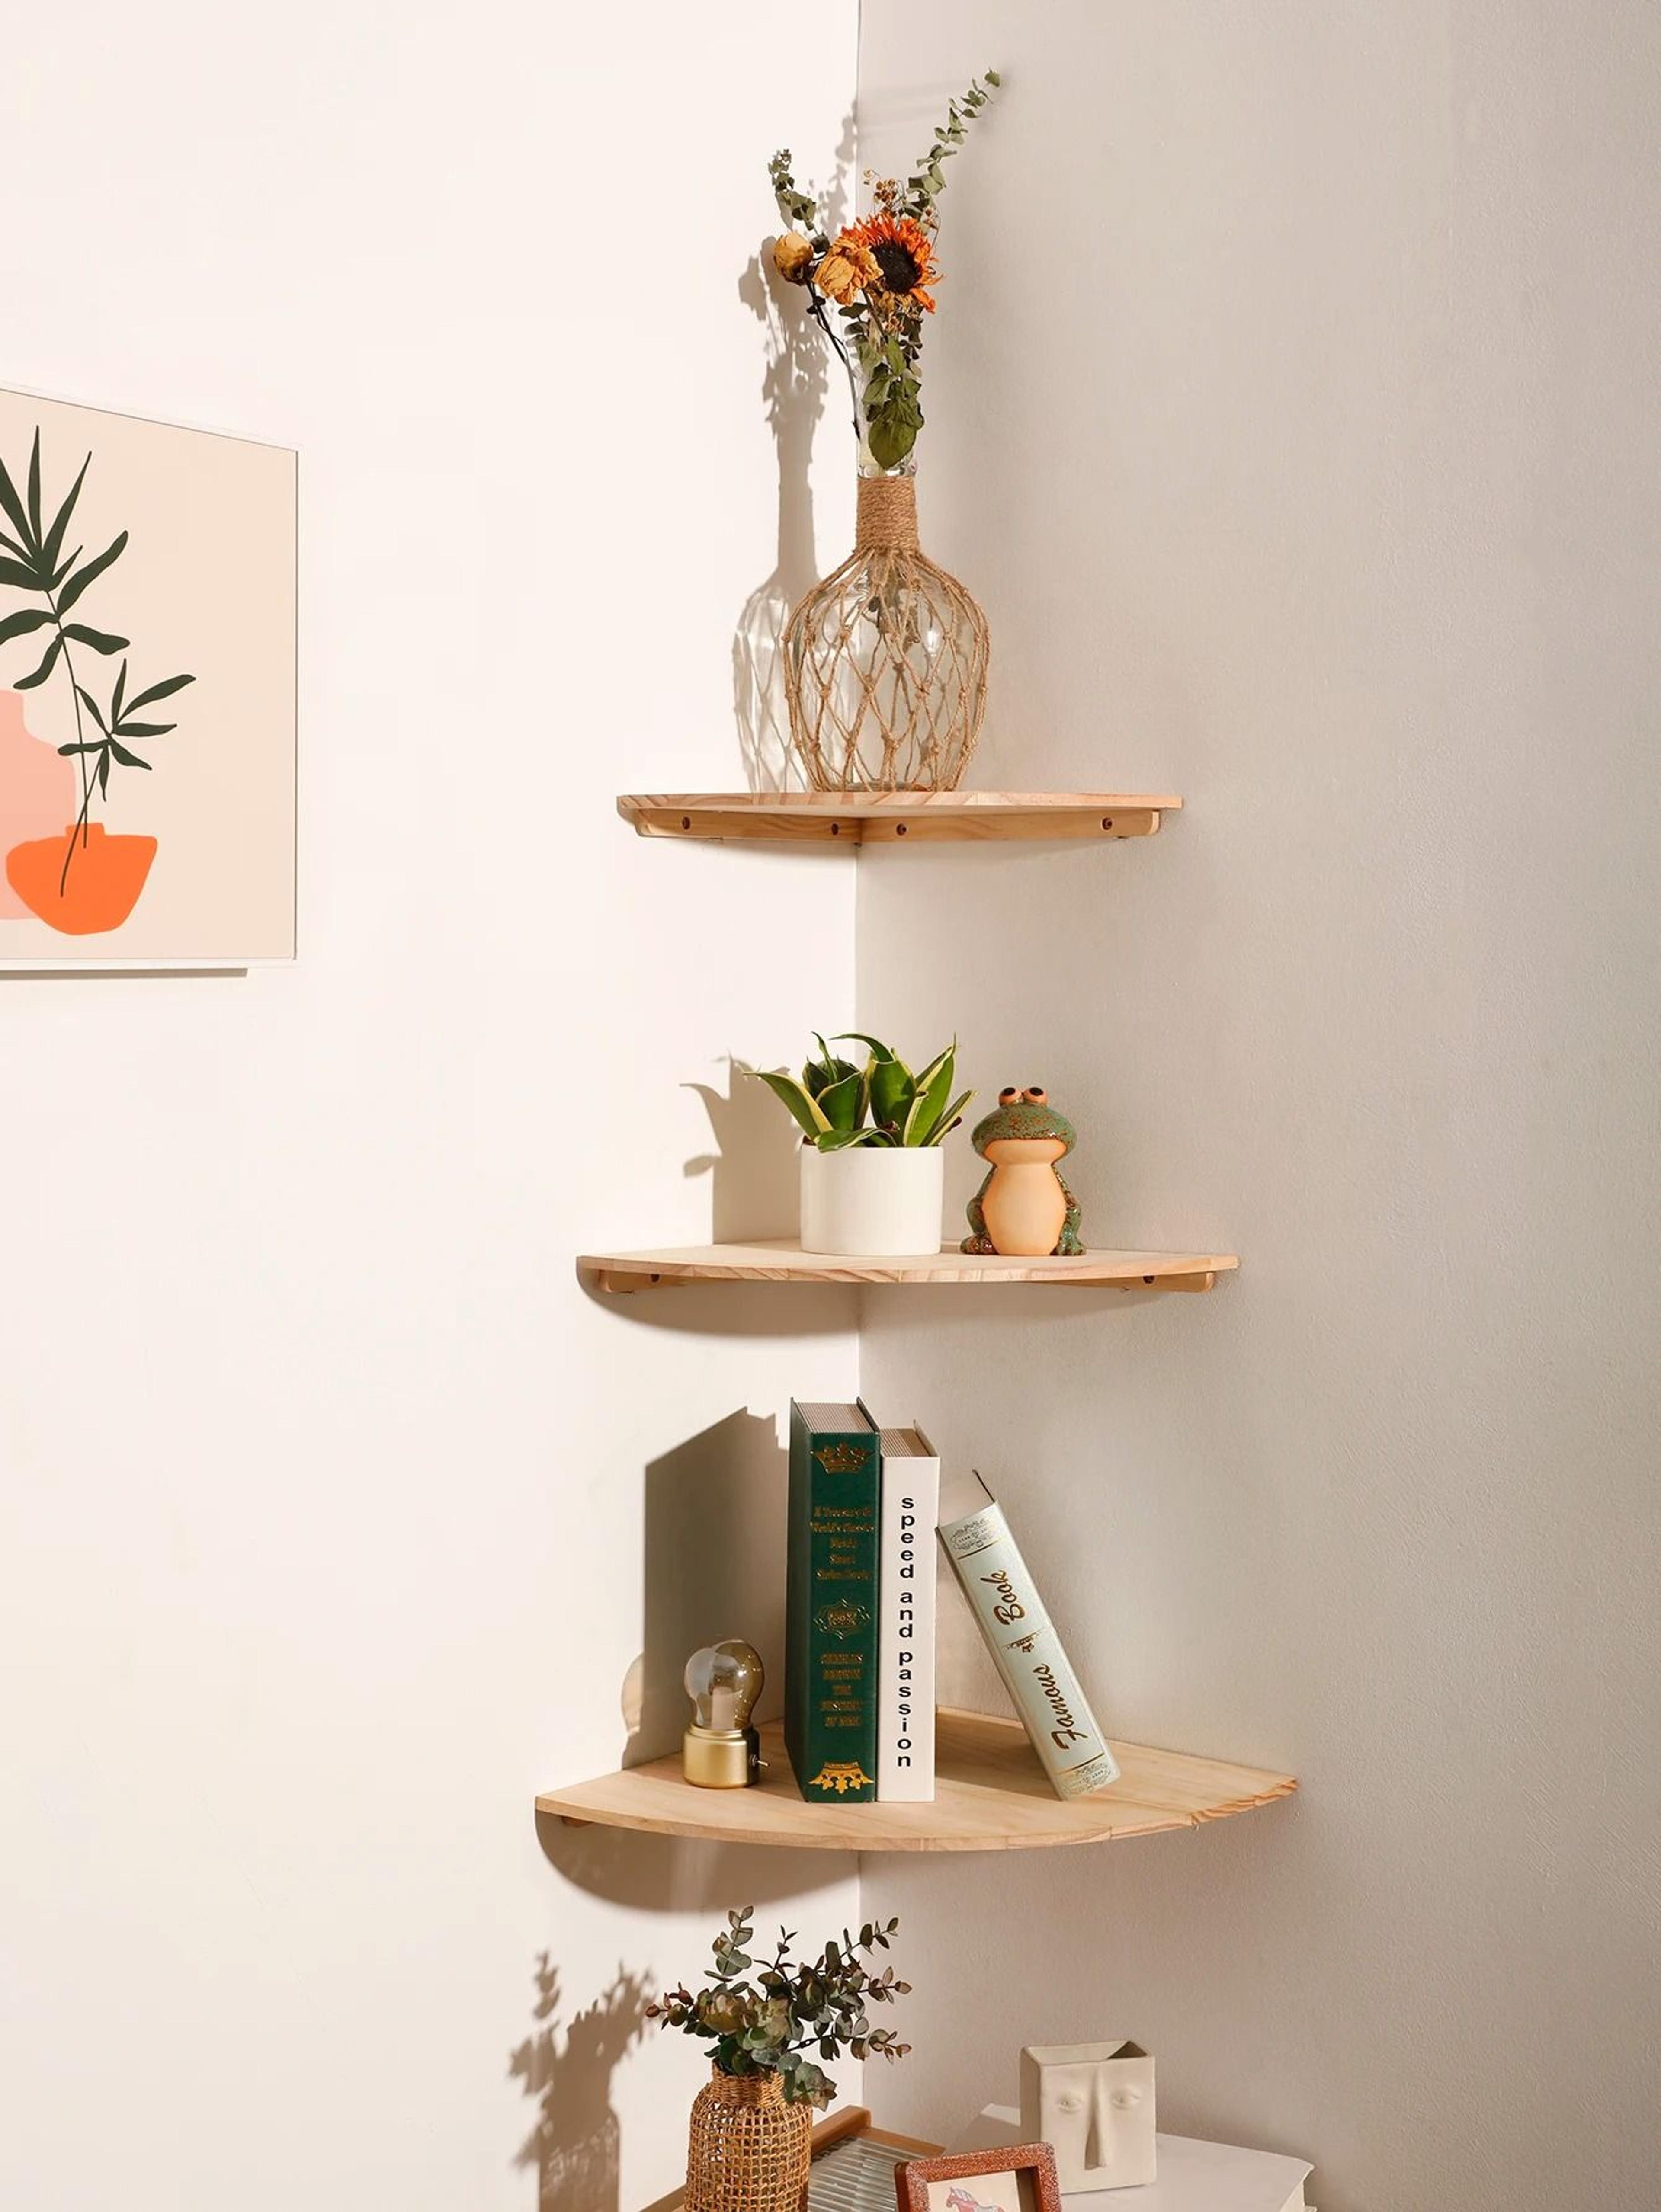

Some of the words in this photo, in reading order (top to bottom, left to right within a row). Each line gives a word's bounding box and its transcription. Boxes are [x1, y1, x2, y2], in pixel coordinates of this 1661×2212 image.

[900, 1497, 915, 1578] speed
[899, 1592, 913, 1638] and
[980, 1569, 1025, 1625] Book
[897, 1652, 913, 1767] passion
[1032, 1663, 1088, 1749] Famous
